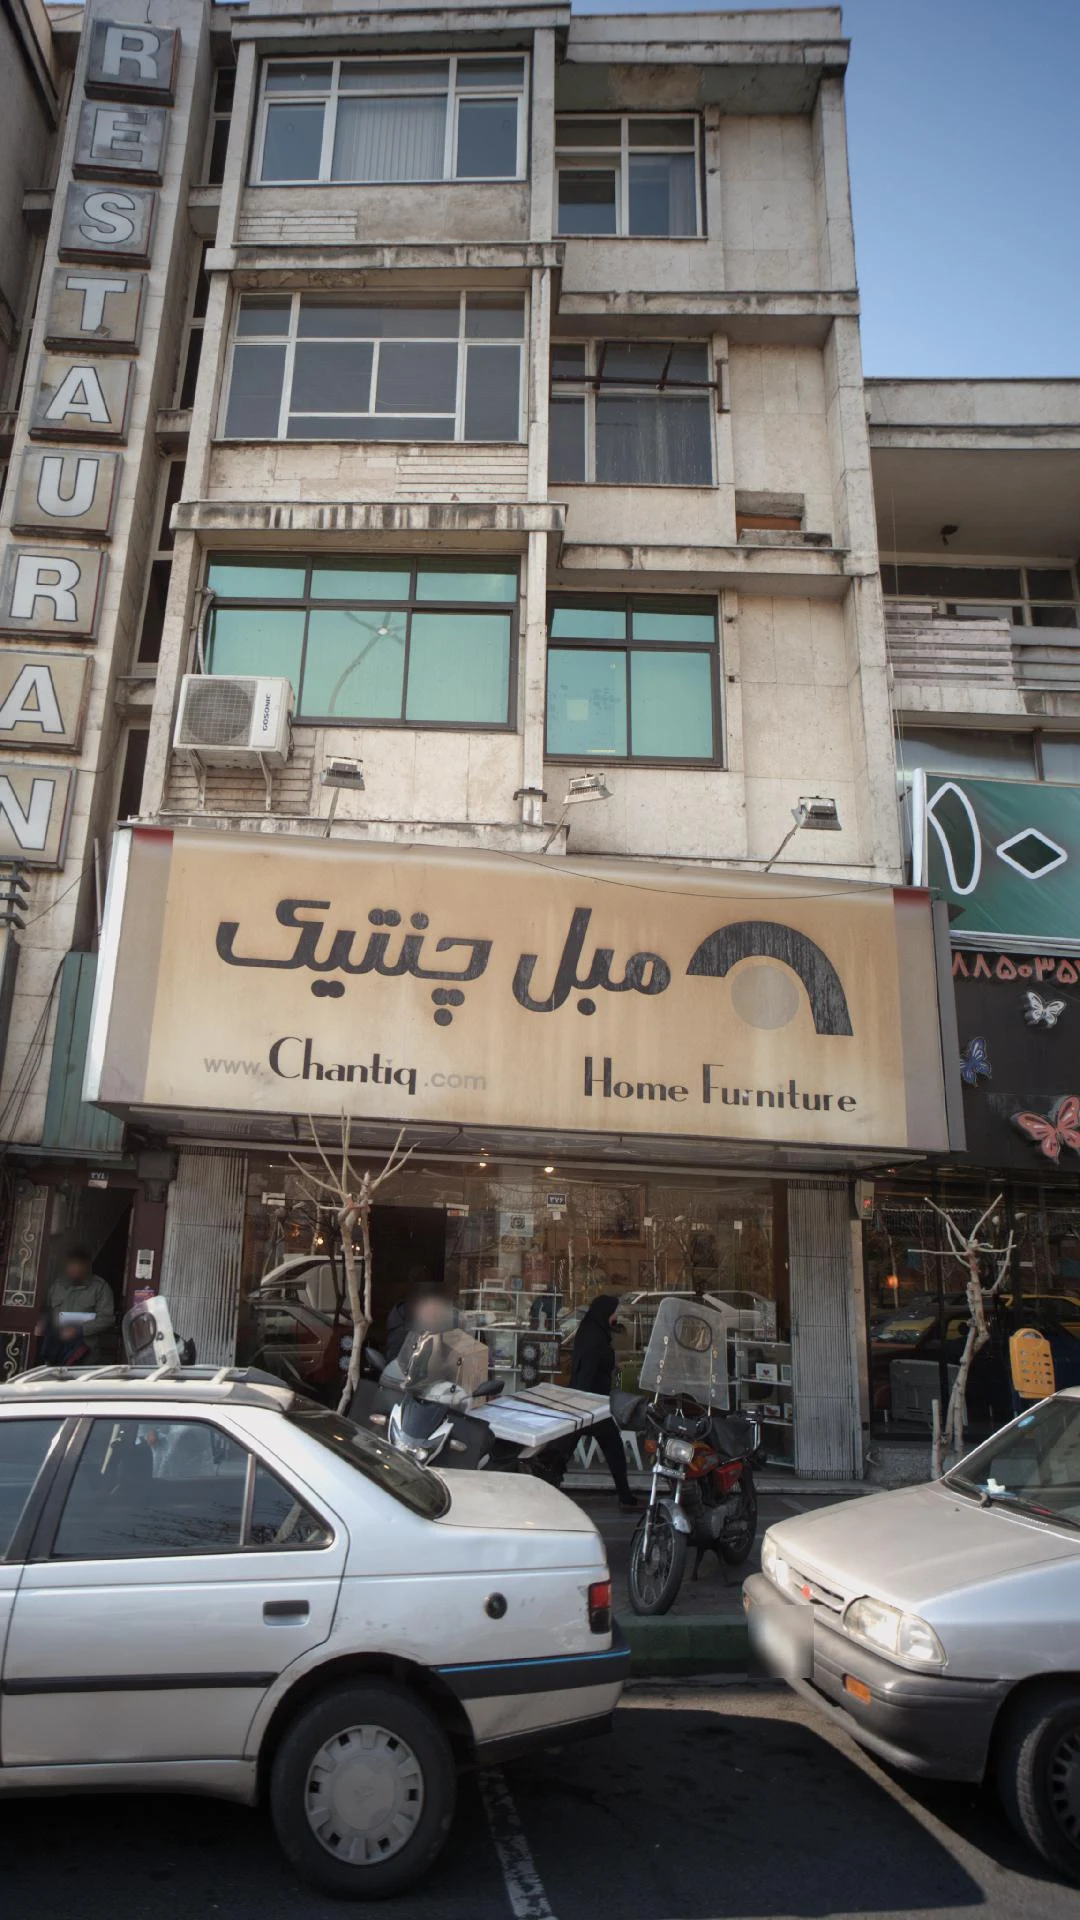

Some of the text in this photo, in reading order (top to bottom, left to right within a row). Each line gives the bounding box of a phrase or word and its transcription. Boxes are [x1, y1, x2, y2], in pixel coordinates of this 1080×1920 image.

[262, 693, 272, 731] GOSONIC
[216, 899, 671, 1026] مبل چنتیک
[952, 952, 1080, 984] ۸۸۵۰۳۵
[584, 1056, 857, 1112] Home Furniture
